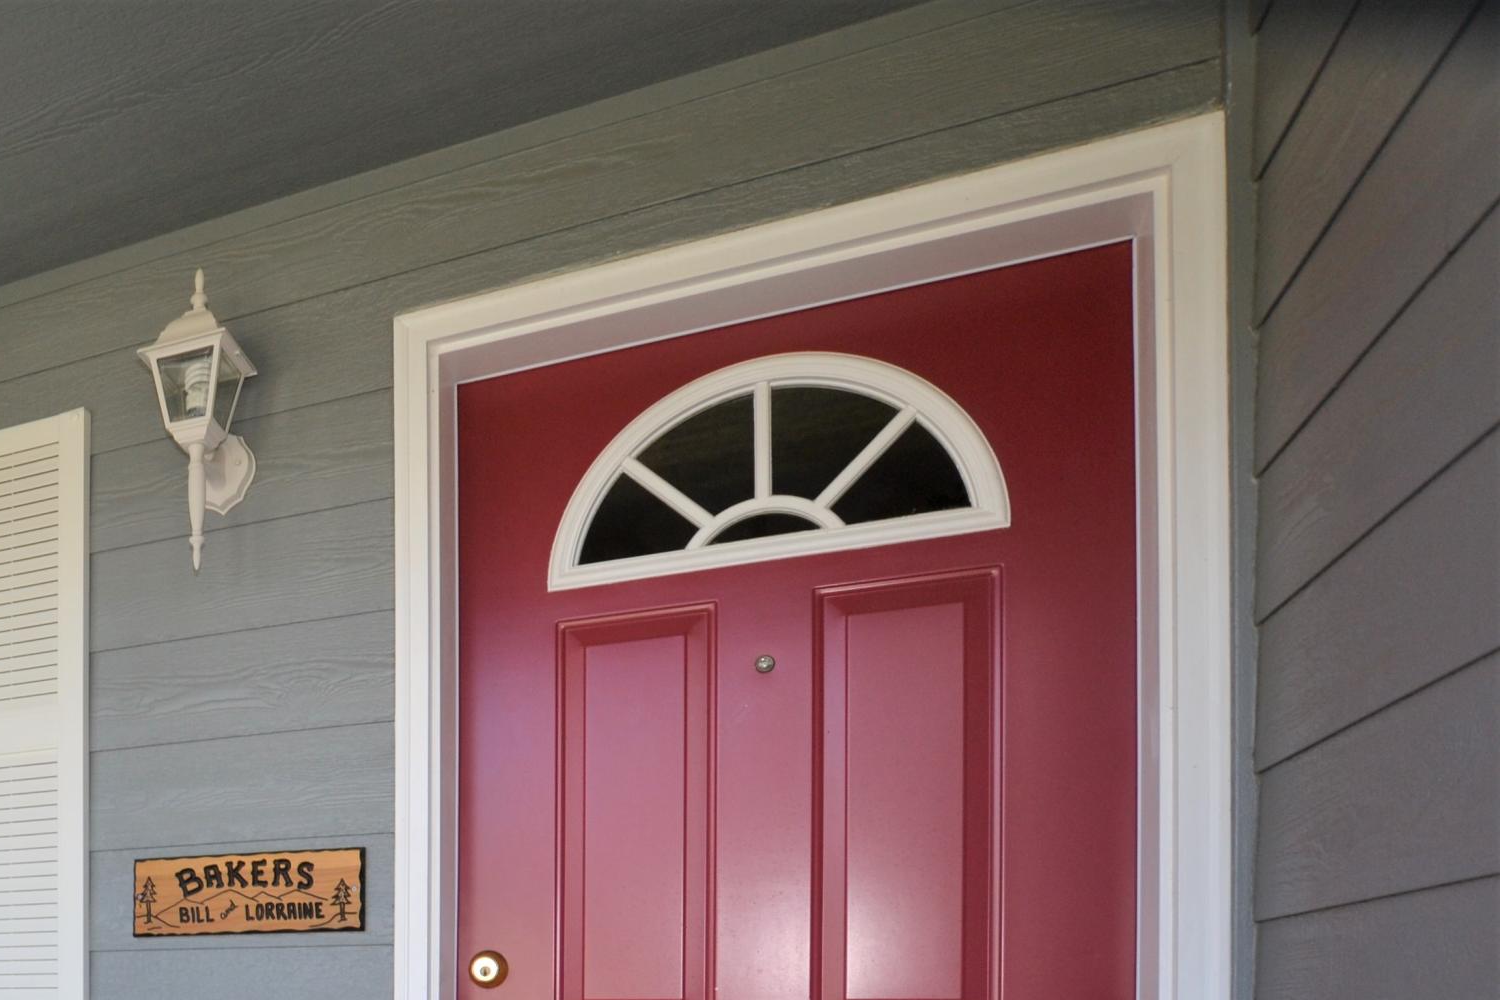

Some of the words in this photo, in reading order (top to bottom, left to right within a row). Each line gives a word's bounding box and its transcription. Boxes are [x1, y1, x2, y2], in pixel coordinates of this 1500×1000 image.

[175, 859, 315, 897] BAKERS
[179, 906, 214, 923] BILL
[220, 899, 238, 920] and
[245, 902, 325, 921] LORRAINE
